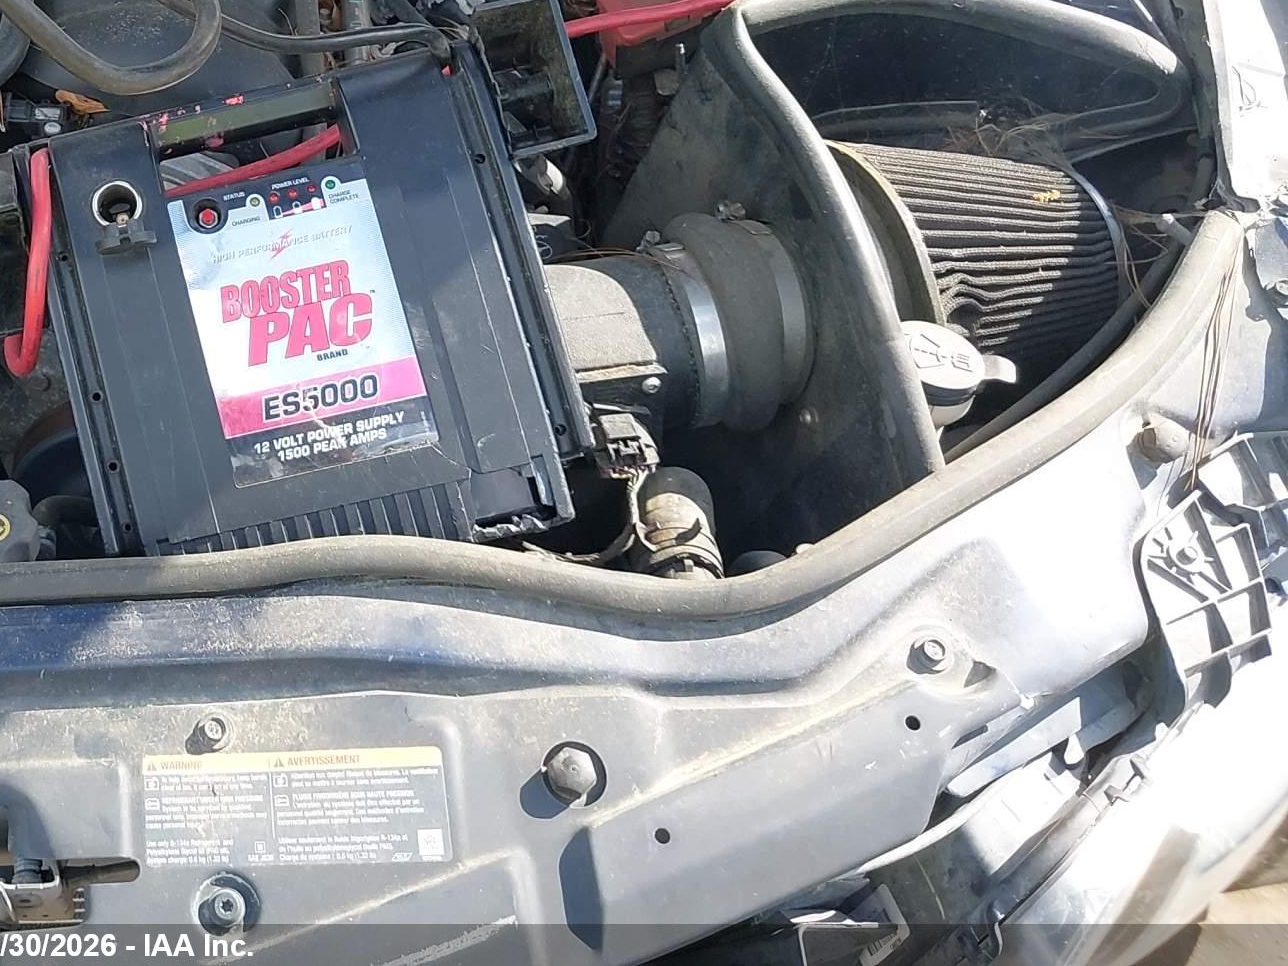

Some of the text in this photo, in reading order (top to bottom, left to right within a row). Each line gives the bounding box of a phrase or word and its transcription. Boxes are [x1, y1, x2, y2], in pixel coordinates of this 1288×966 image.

[271, 176, 310, 190] POWER LEVEL
[222, 191, 246, 202] STATUS
[328, 189, 351, 199] CHARGE
[329, 192, 360, 204] COMPLETE
[231, 215, 261, 227] CHARGING
[212, 224, 353, 264] HIGH PERFORMANCE BATTERY
[220, 259, 352, 323] BOOSTER
[248, 291, 373, 367] PAC
[316, 349, 349, 362] BRAND
[263, 374, 379, 421] ES5000
[253, 442, 270, 455] 12
[272, 433, 305, 452] VOLT
[307, 423, 354, 444] POWER
[355, 411, 405, 432] SUPPLY
[277, 428, 388, 463] 1500 PEAK AMPS
[161, 760, 203, 771] WARNING
[287, 755, 360, 767] AVERTISSEMENT
